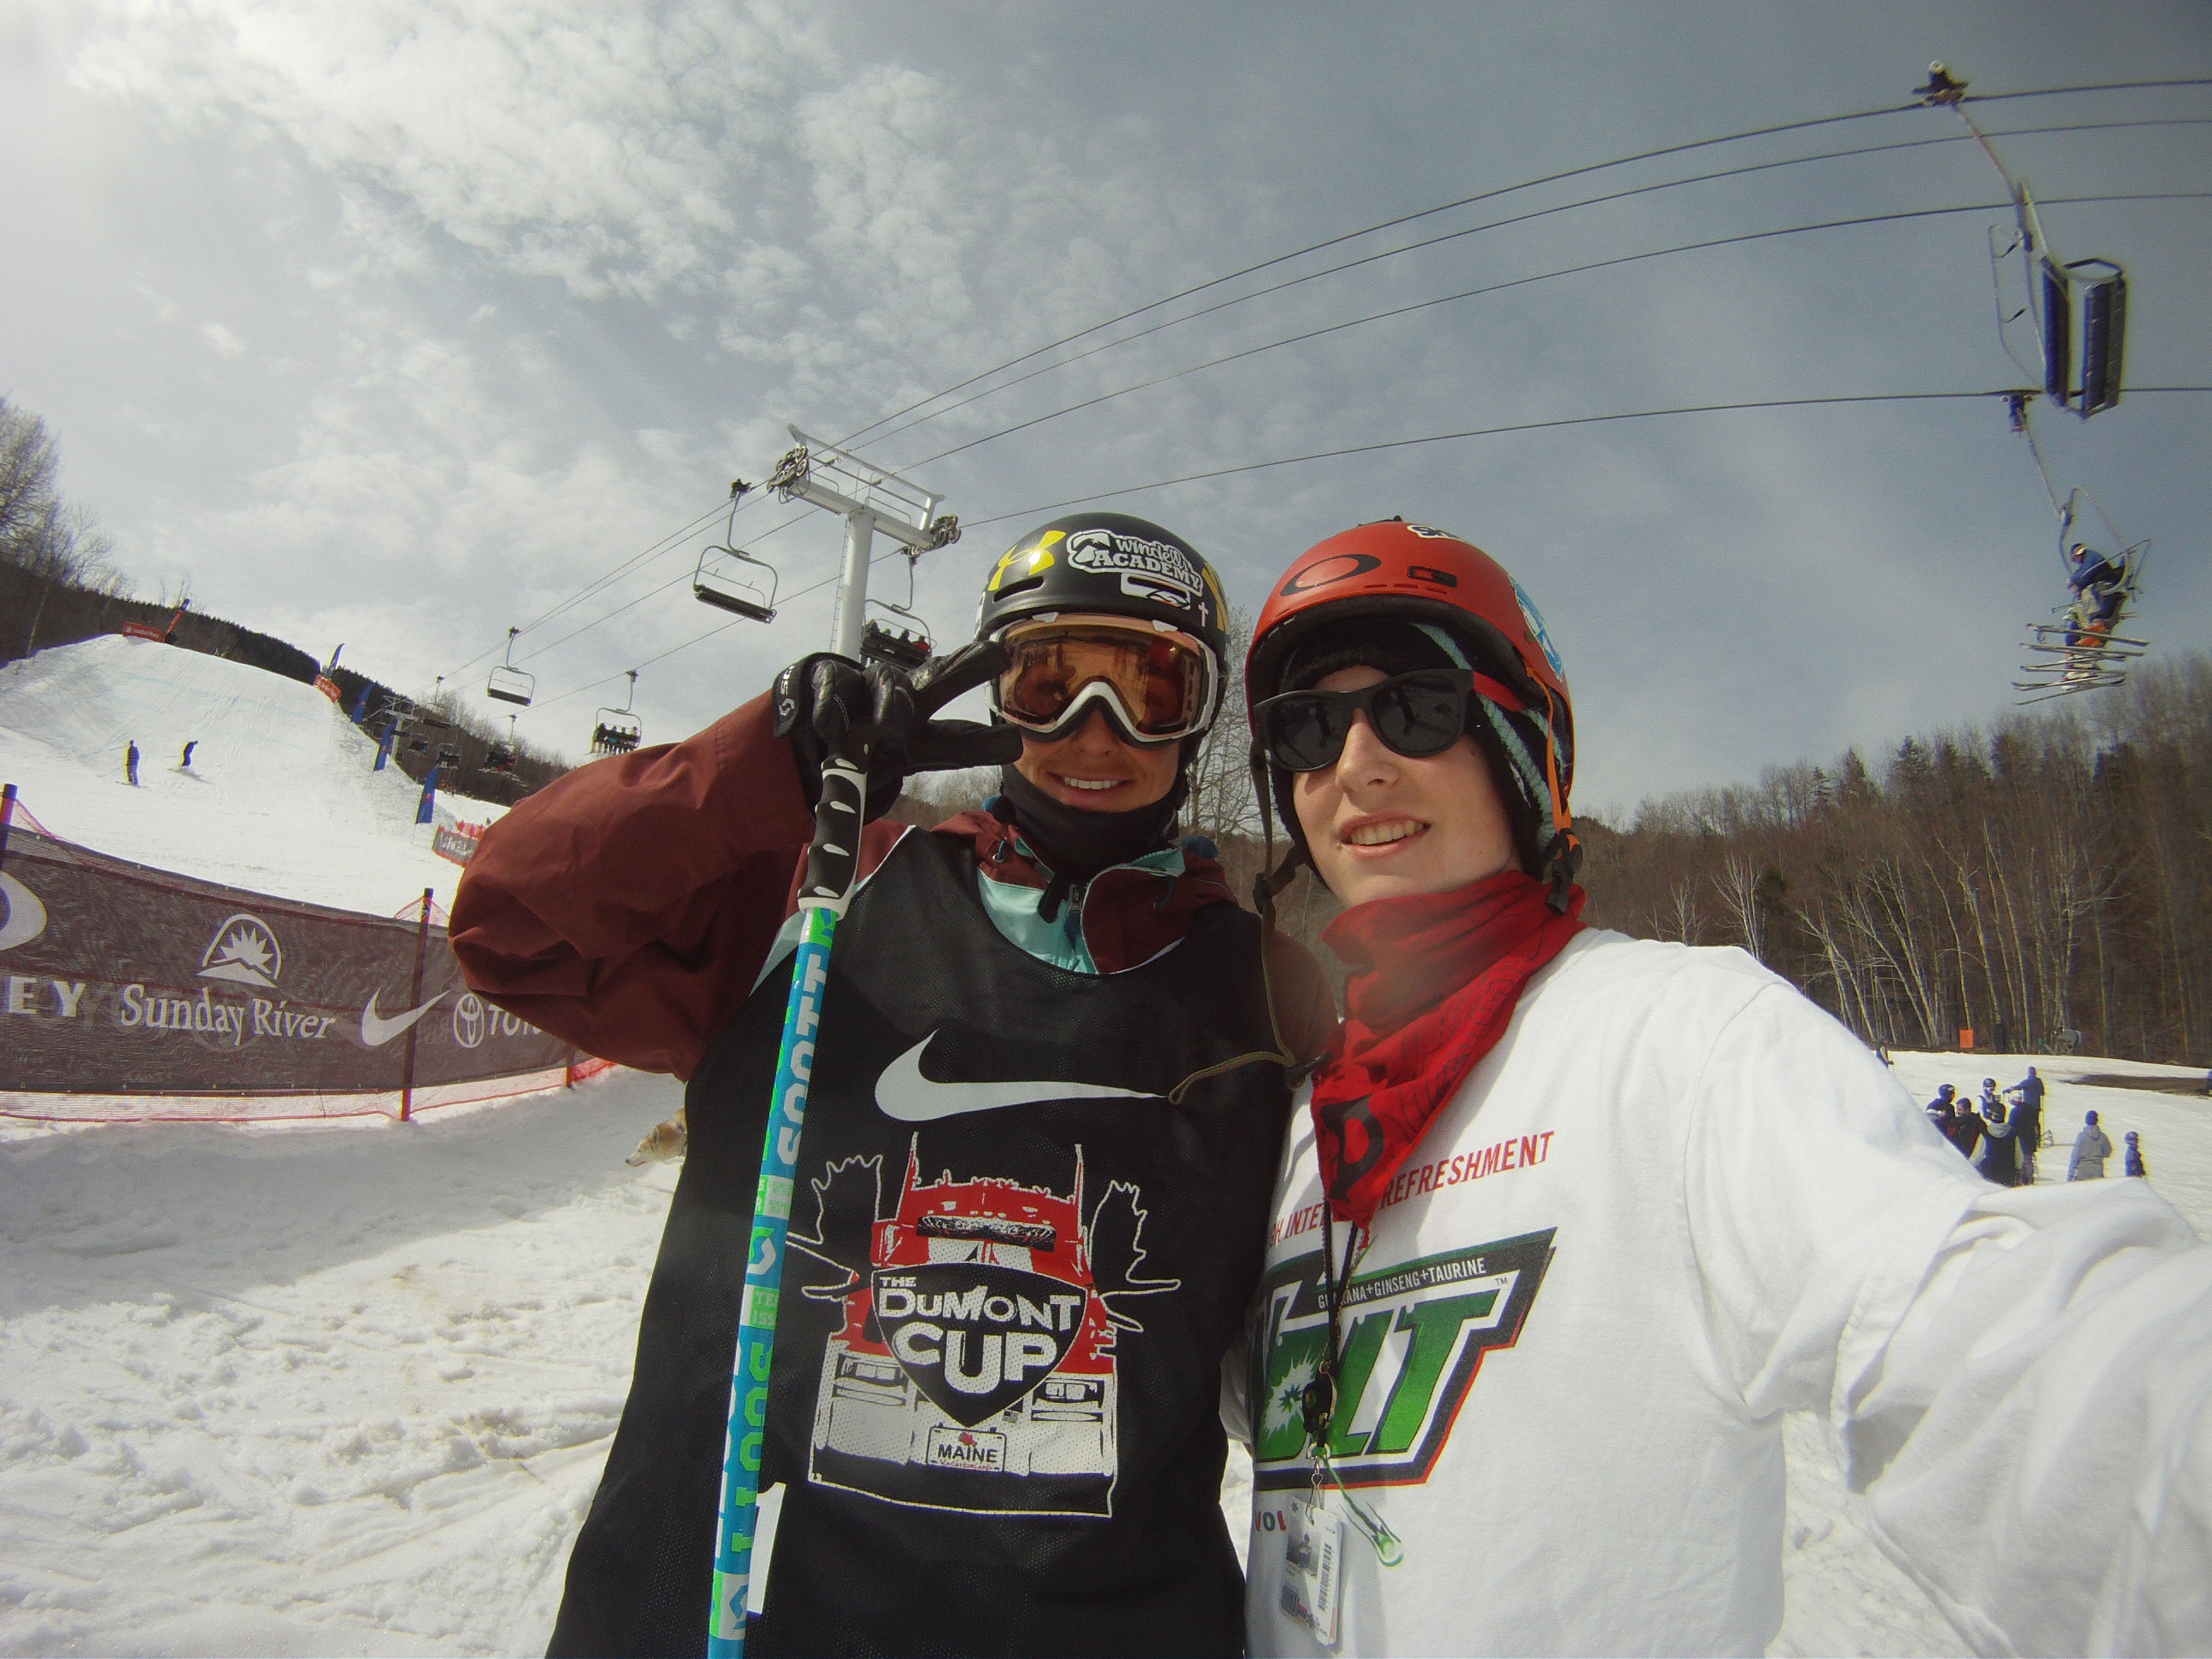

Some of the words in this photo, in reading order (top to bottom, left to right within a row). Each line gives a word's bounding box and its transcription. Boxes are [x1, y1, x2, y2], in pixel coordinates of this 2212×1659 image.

[1092, 550, 1200, 588] ACADEMY
[121, 983, 244, 1046] Sunday
[253, 996, 336, 1039] River
[1378, 1131, 1555, 1210] REFRESHMENT
[879, 1276, 917, 1288] THE
[878, 1285, 1081, 1331] DUMONT
[892, 1321, 1057, 1394] CUP
[938, 1443, 998, 1464] MAINE
